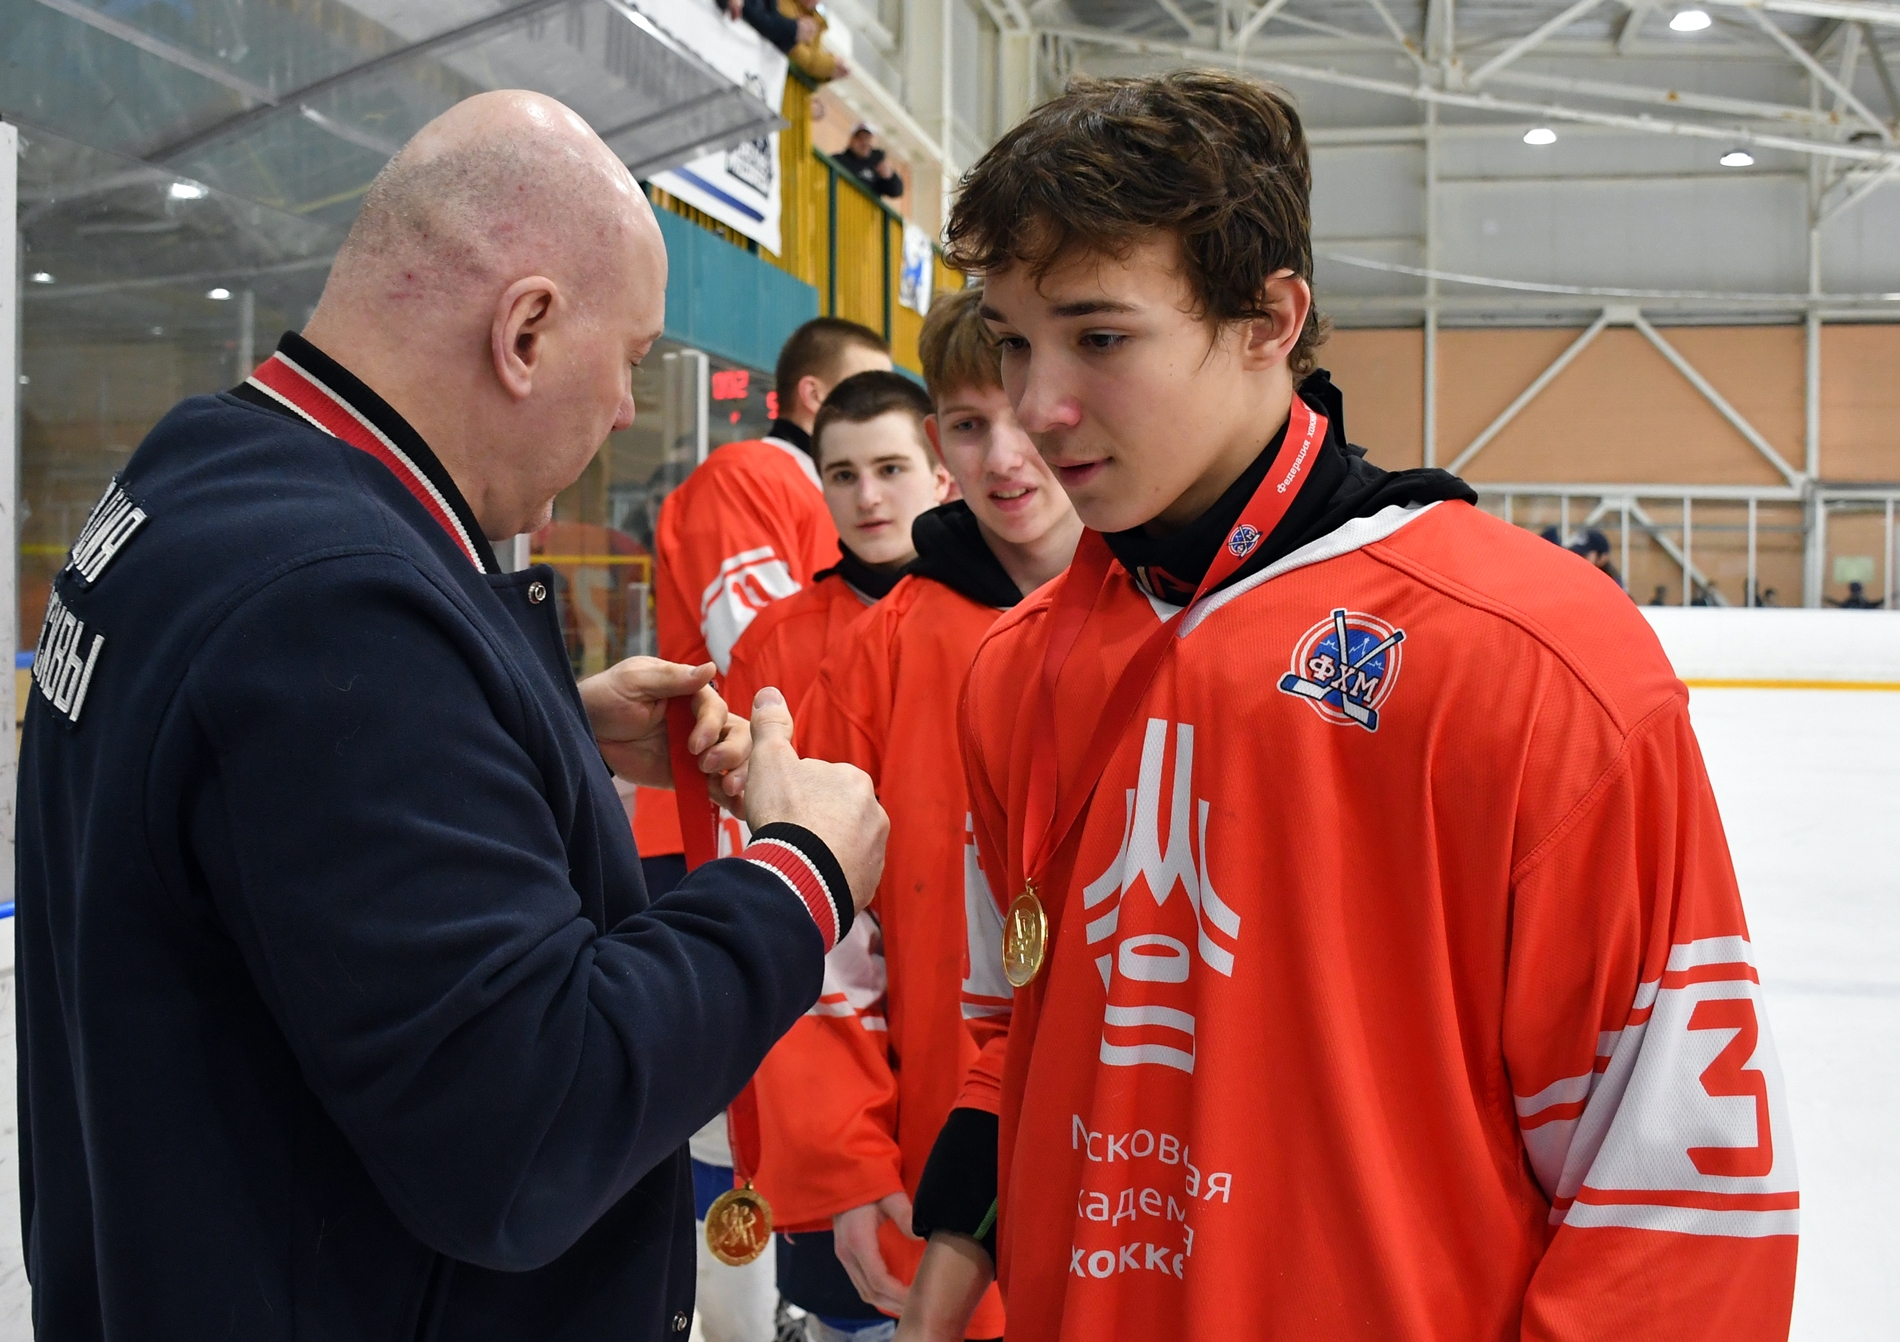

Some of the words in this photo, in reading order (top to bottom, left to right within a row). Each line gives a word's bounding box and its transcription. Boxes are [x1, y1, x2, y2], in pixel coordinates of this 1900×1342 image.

[1277, 439, 1310, 494] Федерация
[1308, 653, 1380, 703] ФХМ
[1686, 998, 1774, 1178] 3
